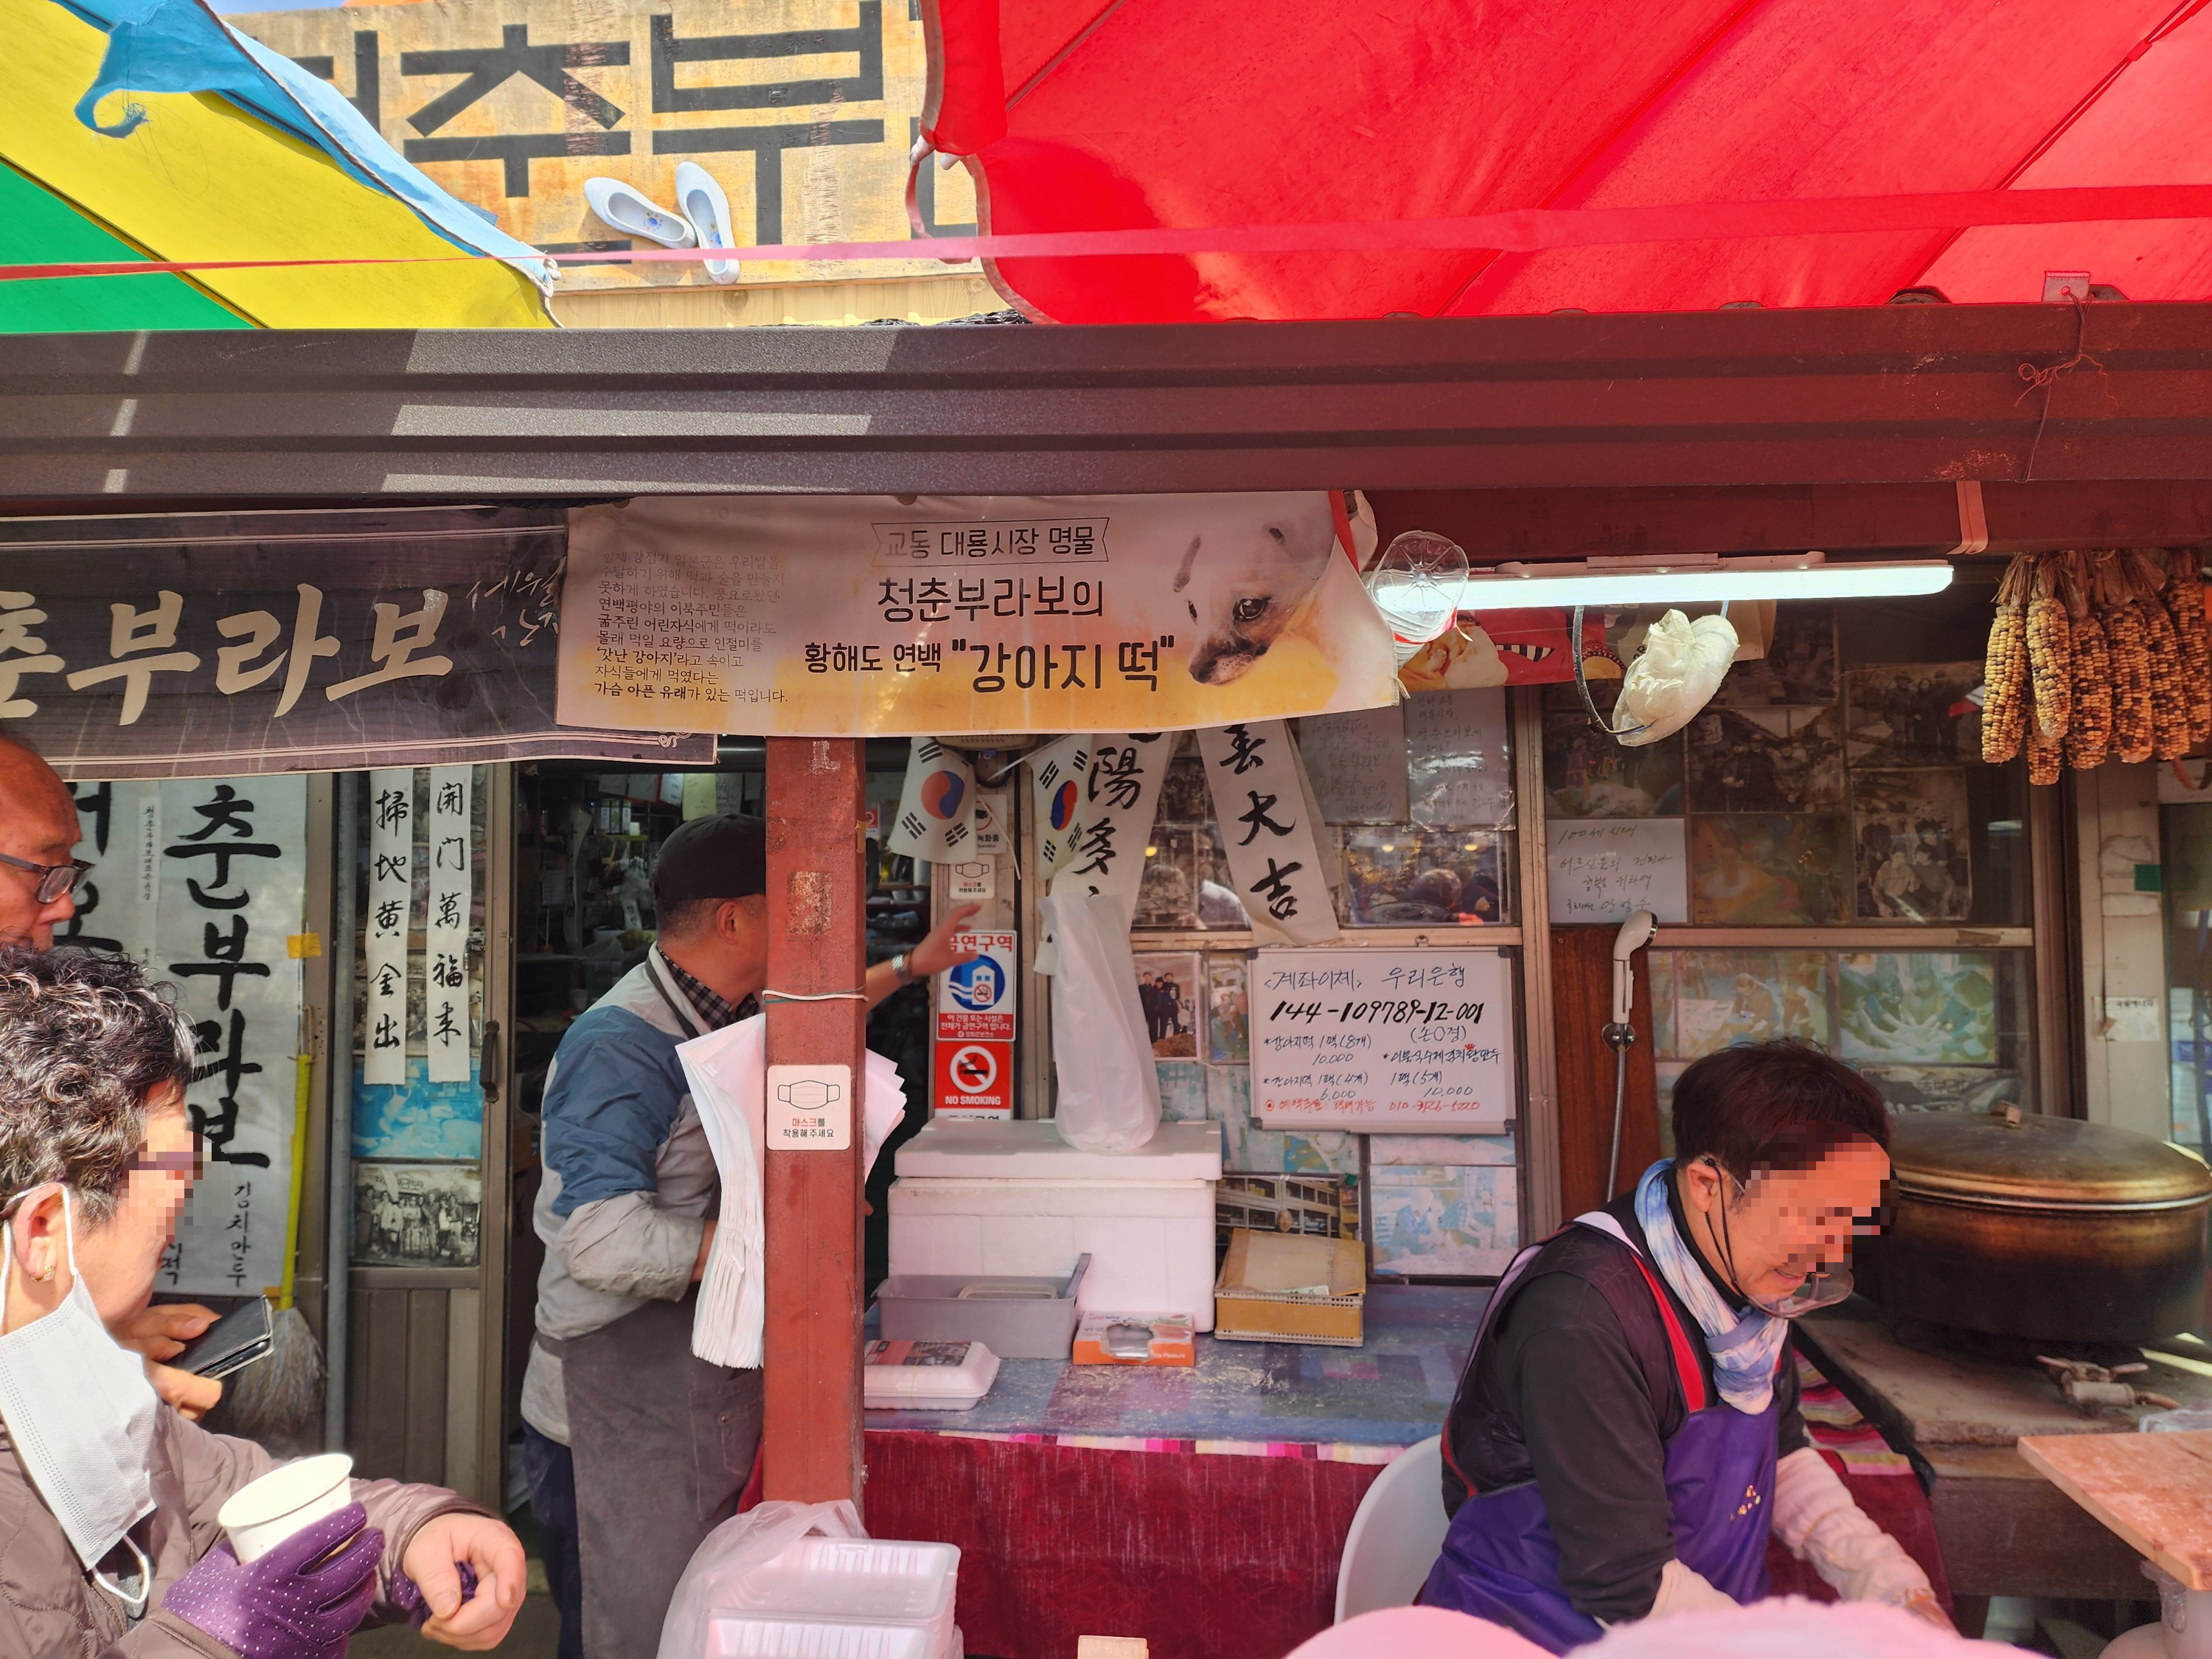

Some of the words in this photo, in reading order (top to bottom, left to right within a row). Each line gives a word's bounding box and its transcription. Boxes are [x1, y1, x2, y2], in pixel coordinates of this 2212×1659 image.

[885, 529, 931, 560] 교동
[940, 527, 1040, 558] 대룡시장
[1048, 525, 1096, 556] 명물
[604, 552, 626, 563] 일제
[633, 552, 669, 564] 강점기
[675, 554, 725, 568] 일본군은
[729, 555, 779, 569] 우리쌀을
[600, 566, 652, 580] 수탈하기
[657, 568, 680, 581] 위해
[687, 571, 712, 584] 떡과
[717, 572, 742, 585] 술을
[747, 571, 784, 586] 만들지
[599, 580, 639, 596] 못하게
[644, 583, 709, 599] 하였습니다.
[877, 575, 1105, 623] 청춘부라보의
[599, 597, 664, 615] 연백평야의
[670, 602, 747, 618] 이북주민들은
[598, 613, 639, 630] 굶주린
[644, 619, 719, 633] 어린자식에게
[725, 620, 776, 635] 떡이라도
[597, 630, 624, 645] 몰래
[629, 632, 654, 648] 먹일
[659, 636, 710, 650] 요량으로
[714, 637, 763, 652] 인절미를
[706, 653, 744, 668] 속이고
[804, 641, 884, 674] 황해도
[892, 641, 941, 673] 연백
[951, 639, 1102, 693] "강아지
[1118, 634, 1175, 692] 떡"
[594, 664, 662, 682] 자식들에게
[668, 669, 719, 685] 먹였다는
[594, 681, 623, 697] 가슴
[627, 684, 655, 699] 아픈
[660, 685, 700, 701] 유래가
[706, 688, 731, 703] 있는
[734, 689, 788, 703] 떡입니다.
[1381, 963, 1466, 990] 우리은행
[945, 1096, 959, 1105] NO
[960, 1096, 1001, 1105] SMOKING
[792, 1118, 825, 1127] 마스크를
[783, 1129, 807, 1138] 착용해
[810, 1129, 834, 1138] 주세요
